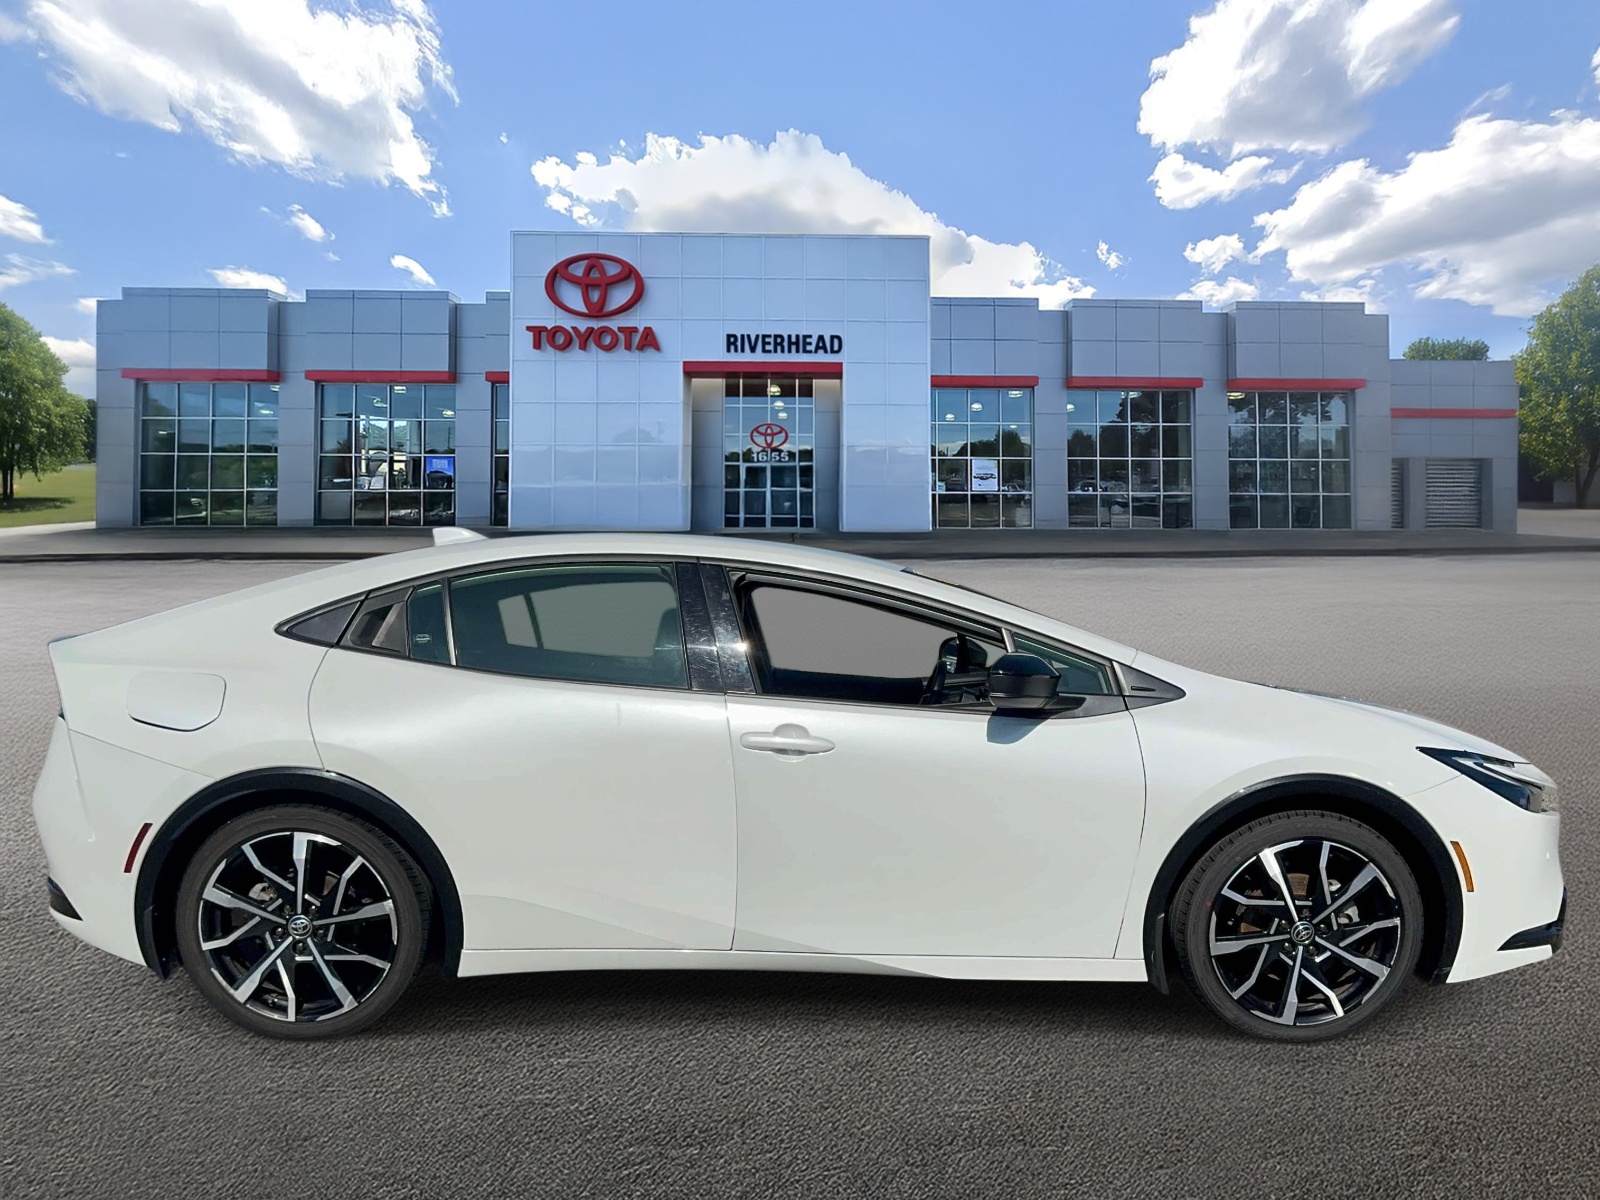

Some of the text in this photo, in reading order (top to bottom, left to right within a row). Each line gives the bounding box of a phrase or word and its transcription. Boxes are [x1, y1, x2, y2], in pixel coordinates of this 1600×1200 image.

[525, 325, 661, 352] TOYOTA
[726, 333, 843, 355] RIVERHEAD
[751, 451, 789, 462] 1655
